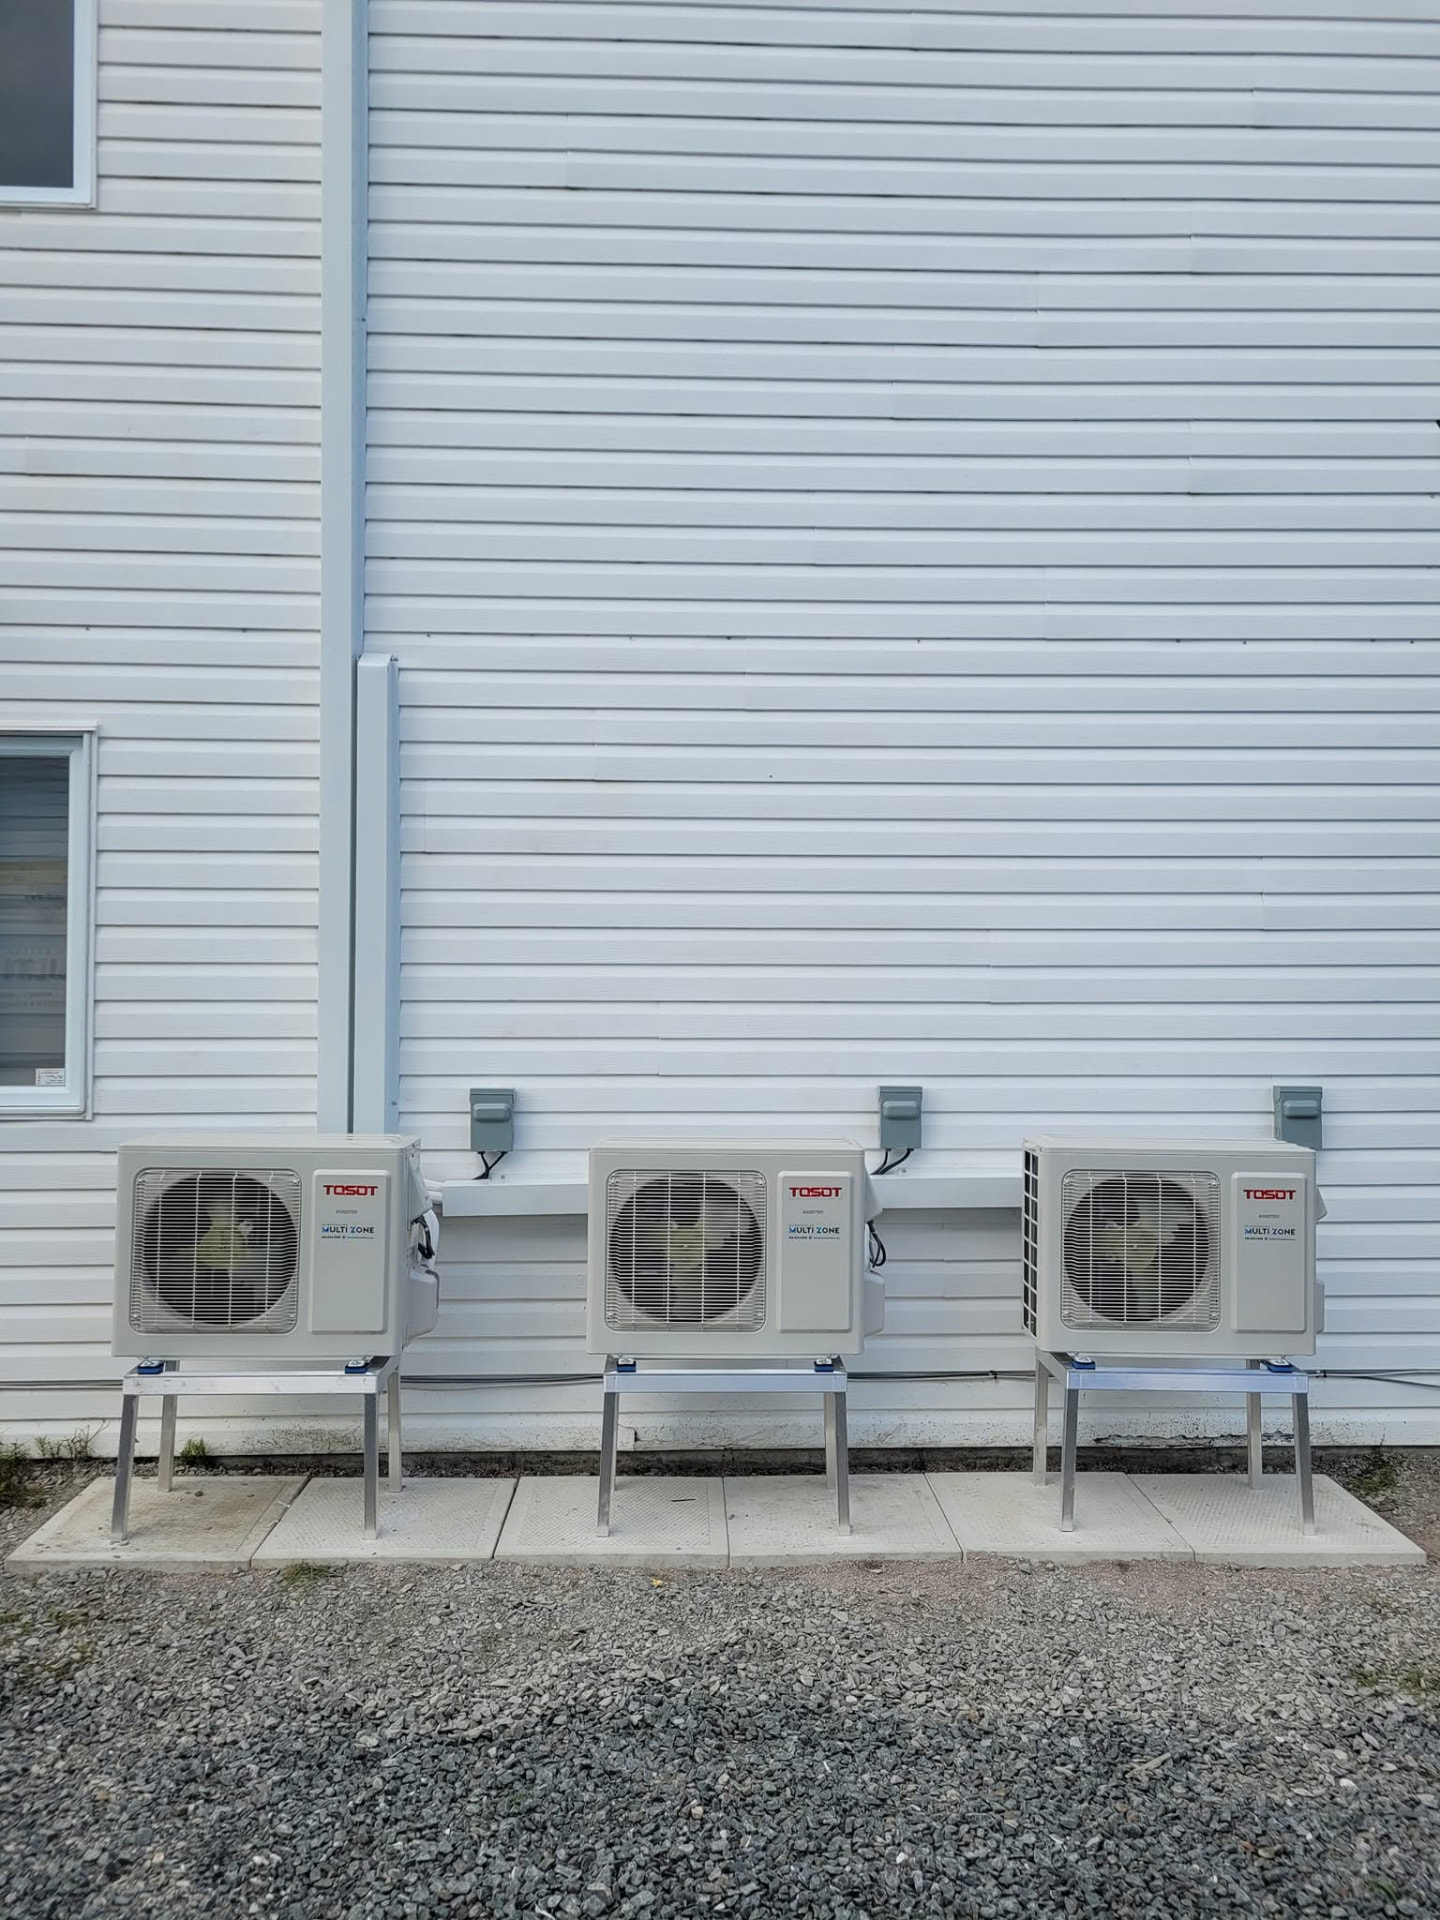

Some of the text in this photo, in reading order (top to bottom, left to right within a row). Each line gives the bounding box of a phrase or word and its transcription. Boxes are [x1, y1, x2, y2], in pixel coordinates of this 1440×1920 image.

[323, 1184, 378, 1196] TOSOT
[789, 1187, 842, 1197] TOSOT
[1243, 1189, 1296, 1200] TOSOT
